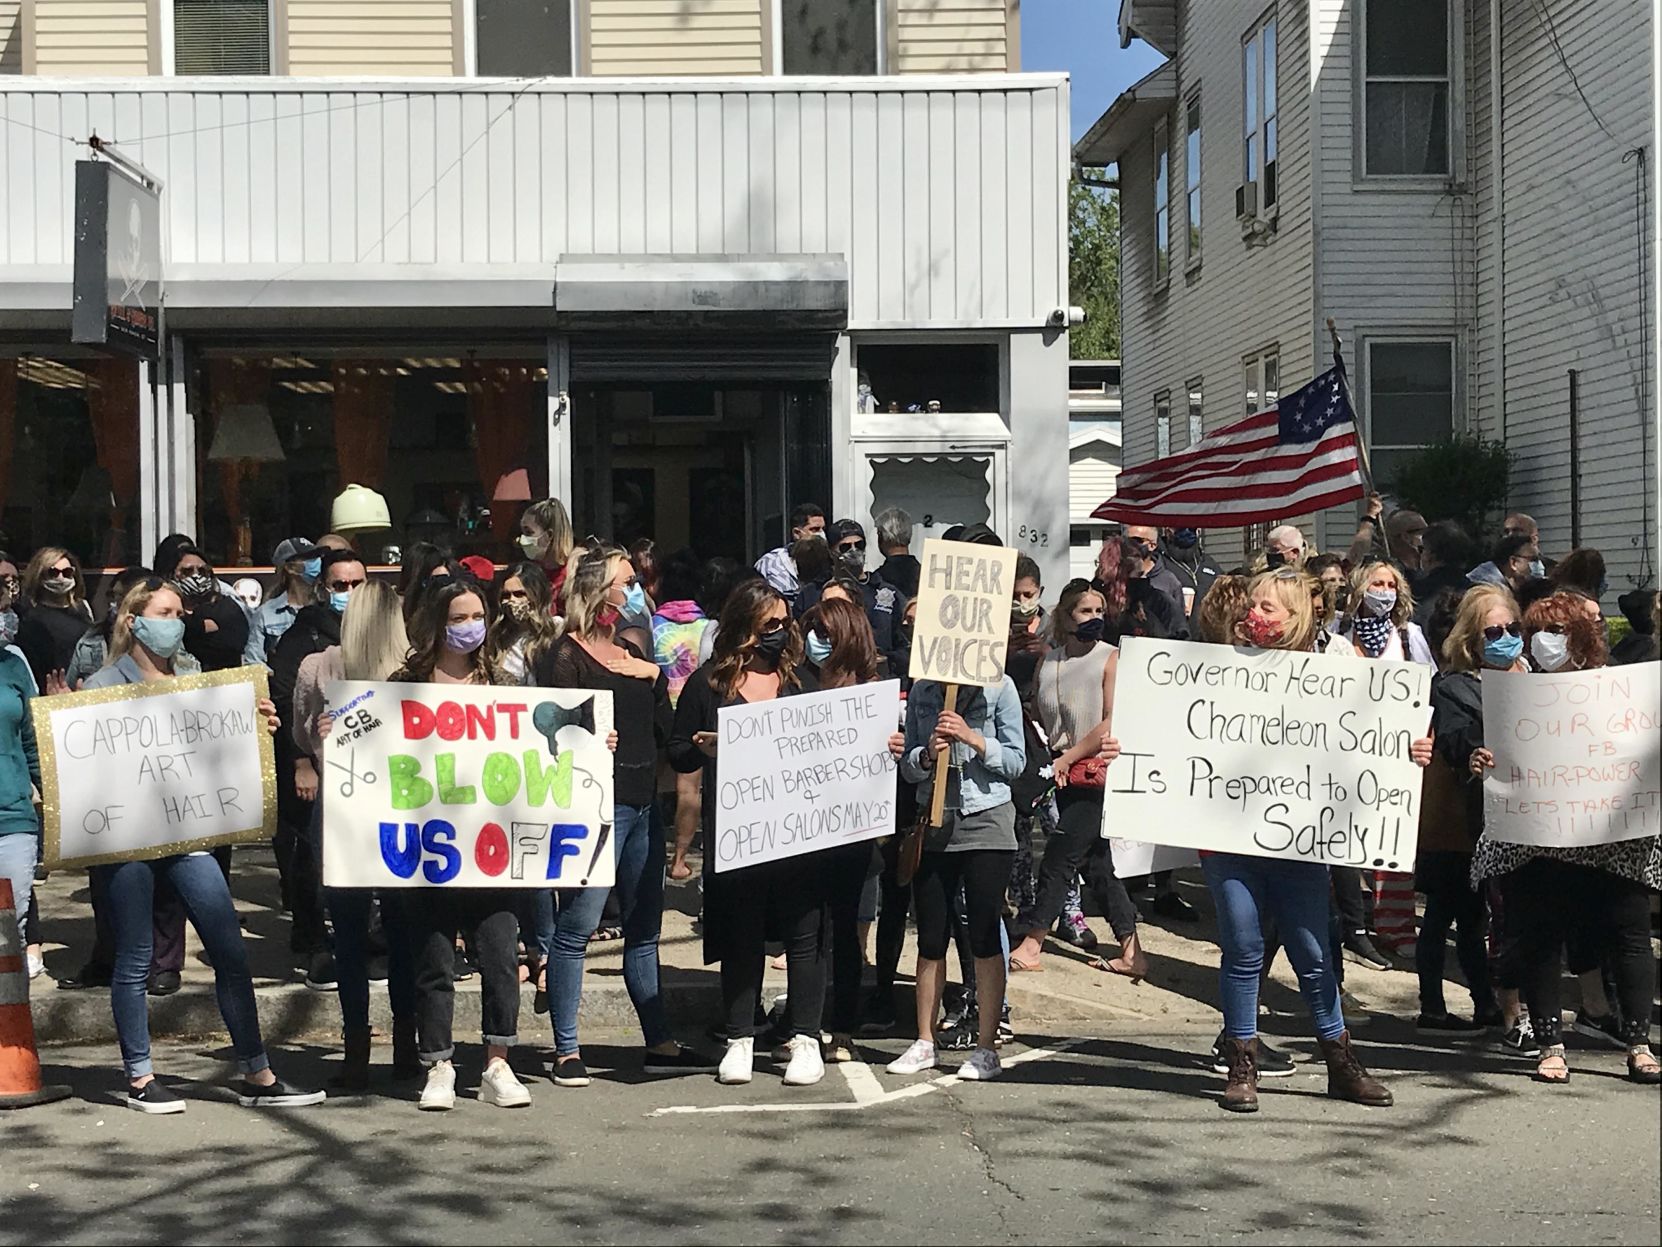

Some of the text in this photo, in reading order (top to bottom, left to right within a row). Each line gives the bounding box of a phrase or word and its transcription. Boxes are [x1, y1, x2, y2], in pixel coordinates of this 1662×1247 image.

[923, 514, 933, 528] 2
[1018, 524, 1049, 548] 832
[928, 554, 1003, 595] HEAR
[938, 593, 995, 635] OUR
[918, 634, 1005, 683] VOICES
[1147, 651, 1423, 708] Governor Hear US!
[64, 708, 256, 760] CAPPOLA-BROKAW
[336, 718, 383, 749] ART OF HAIR
[343, 708, 373, 730] CB
[400, 699, 528, 742] DON'T
[780, 701, 834, 734] PUNISH
[840, 693, 879, 722] THE
[1186, 698, 1414, 763] Chameleon Salon
[1514, 712, 1595, 742] OUR
[773, 727, 859, 760] PREPARED
[1588, 741, 1617, 757] FB
[138, 751, 198, 786] ART
[387, 748, 574, 811] BLOW
[1111, 752, 1412, 816] Is Prepared to Open
[1510, 760, 1643, 789] HAIR-POWER
[82, 786, 244, 835] OF HAIR
[720, 774, 775, 811] OPEN
[1566, 795, 1624, 815] TAKE
[718, 819, 777, 862] OPEN
[781, 804, 842, 846] SALONS
[843, 800, 874, 830] MAY
[1253, 803, 1401, 868] Safely!!
[378, 818, 612, 886] US OFF!
